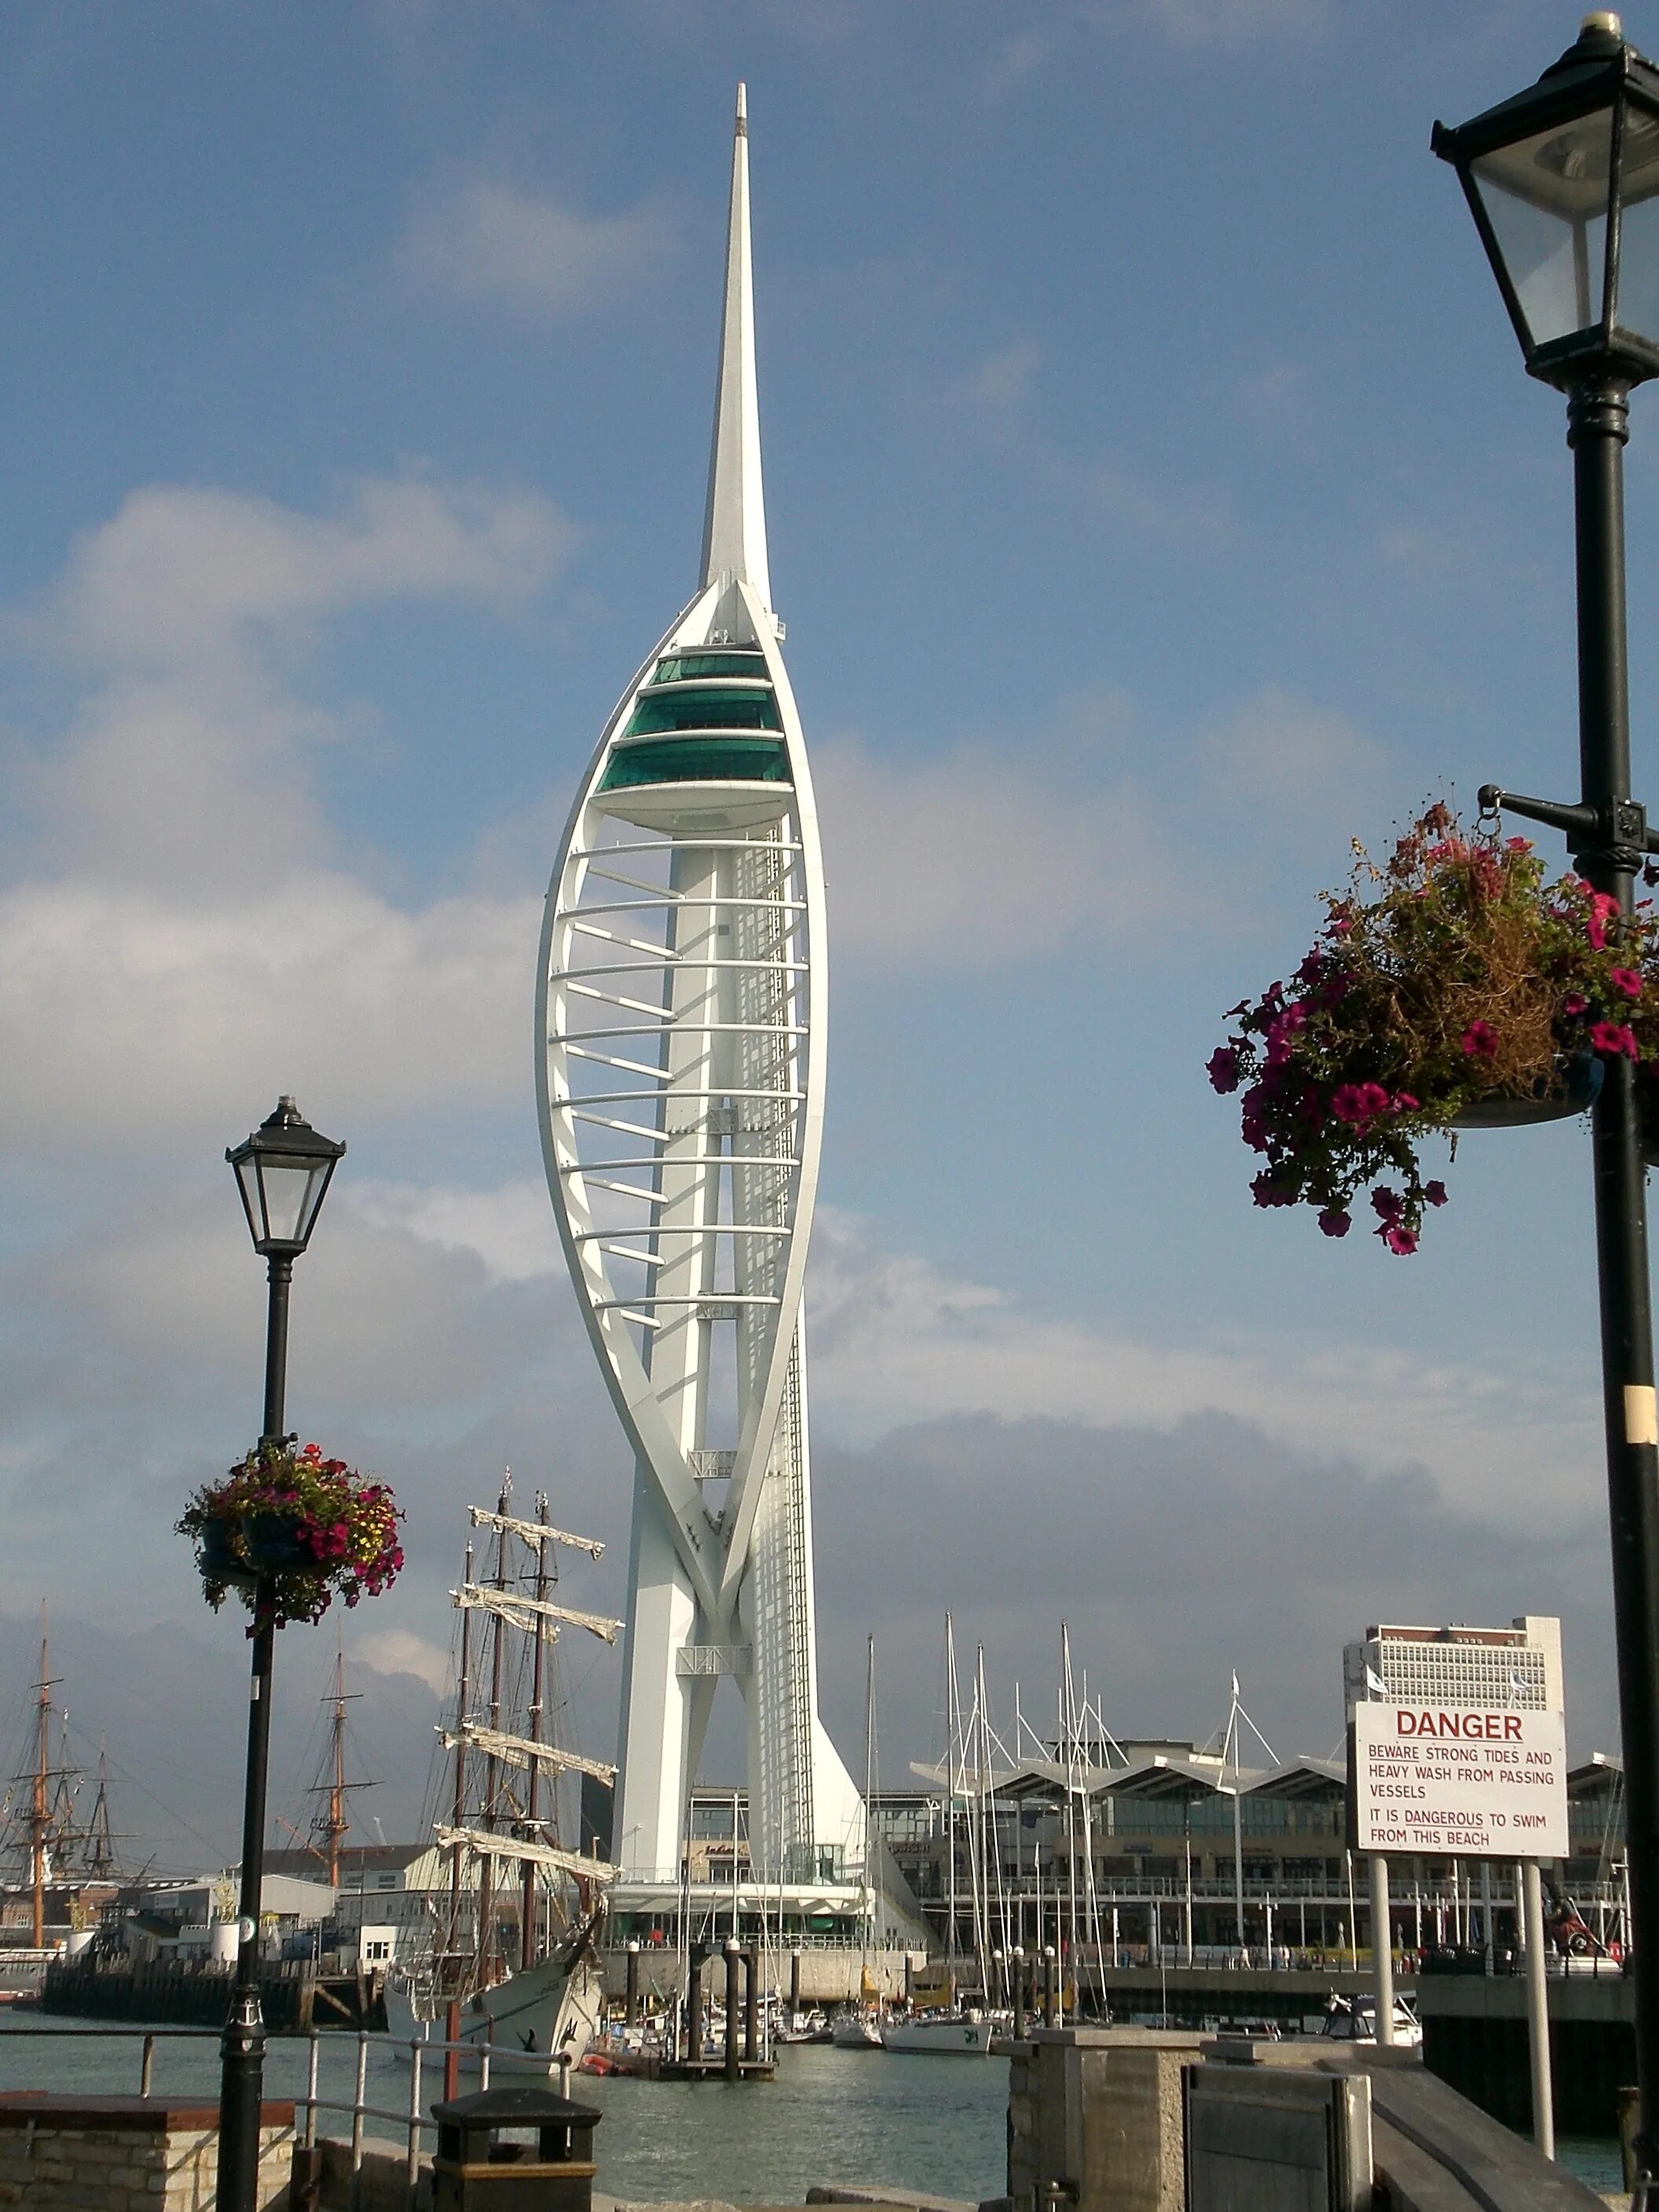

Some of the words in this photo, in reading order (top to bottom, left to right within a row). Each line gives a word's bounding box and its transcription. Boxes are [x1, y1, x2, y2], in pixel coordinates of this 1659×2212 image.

[1397, 1710, 1523, 1740] DANGER
[1368, 1744, 1419, 1760] BEWARE
[1426, 1747, 1478, 1762] STRONG
[1484, 1749, 1519, 1763] TIDES
[1525, 1752, 1552, 1765] AND
[1369, 1764, 1409, 1779] HEAVY
[1415, 1767, 1452, 1781] WASH
[1457, 1768, 1493, 1782] FROM
[1500, 1770, 1555, 1785] PASSING
[1370, 1784, 1426, 1799] VESSELS
[1370, 1808, 1380, 1822] IT
[1386, 1809, 1398, 1822] IS
[1404, 1810, 1483, 1826] DANGEROUS
[1489, 1813, 1507, 1827] TO
[1513, 1815, 1547, 1828] SWIM
[1371, 1829, 1407, 1843] FROM
[1413, 1830, 1441, 1844] THIS
[1447, 1832, 1489, 1846] BEACH
